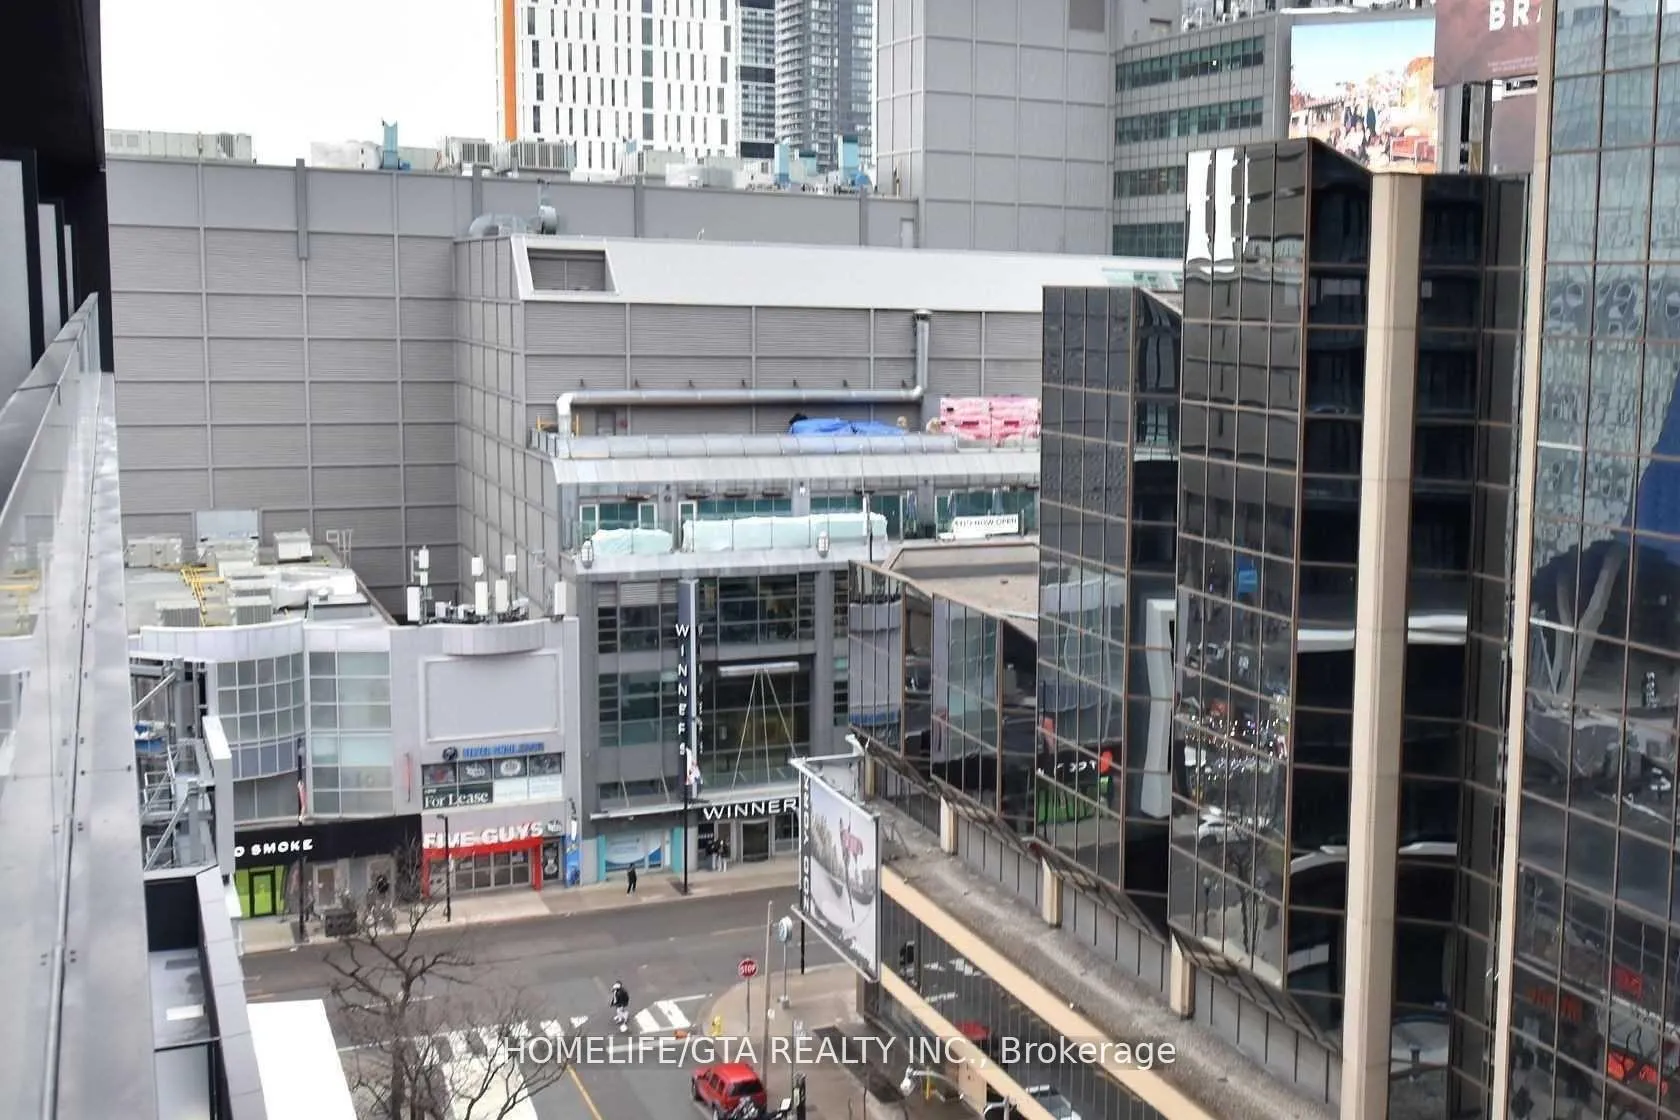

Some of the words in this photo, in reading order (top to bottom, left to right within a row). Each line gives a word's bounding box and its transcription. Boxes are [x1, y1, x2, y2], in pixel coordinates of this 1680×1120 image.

[1489, 0, 1542, 31] BR
[424, 796, 445, 809] For
[448, 792, 489, 807] Lease
[423, 831, 475, 850] FIVE
[481, 820, 544, 845] GUYS
[250, 838, 314, 857] SMOKE
[739, 964, 757, 974] STOP
